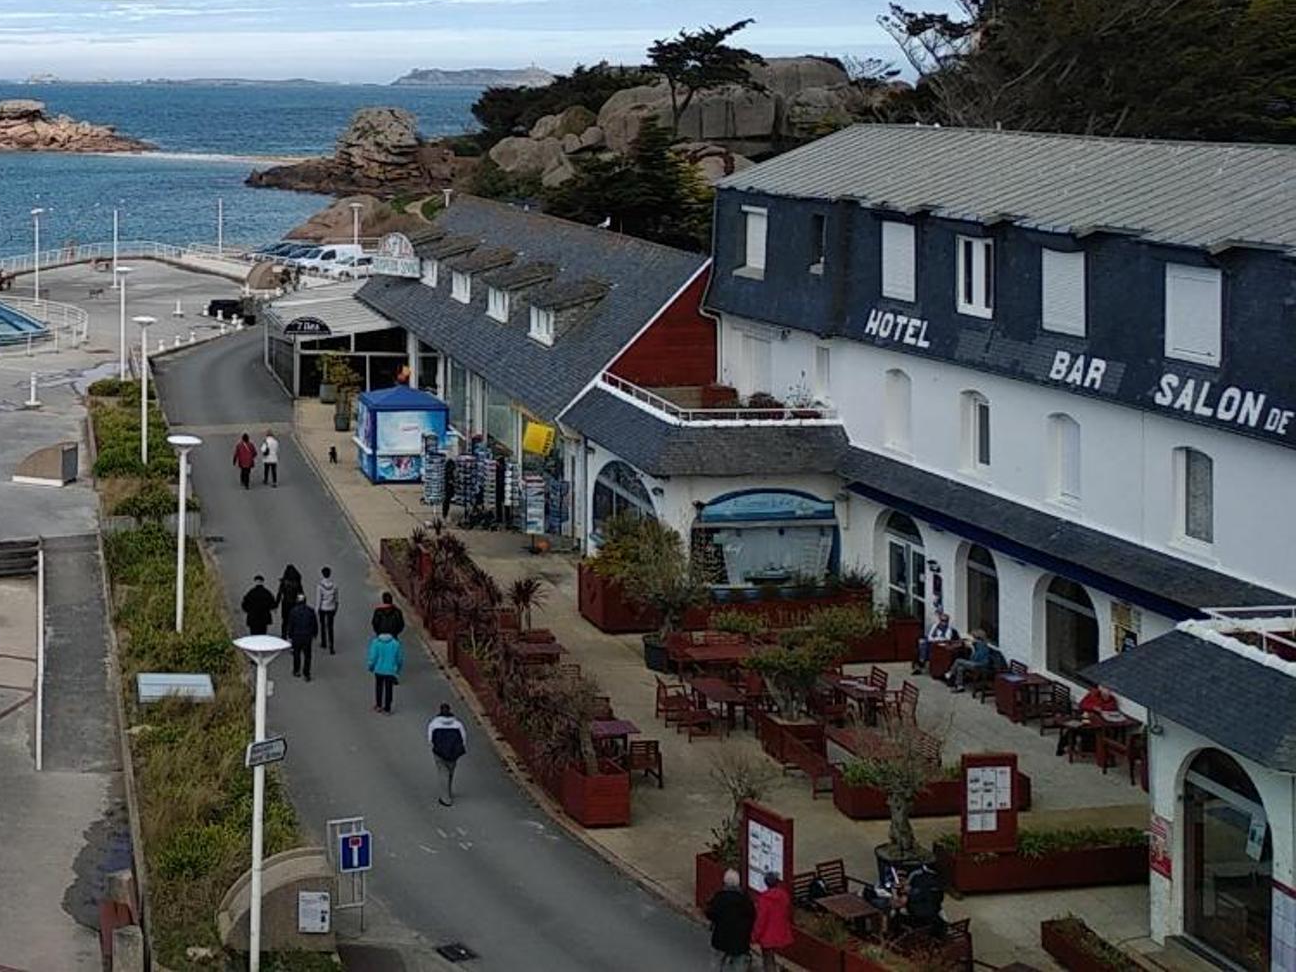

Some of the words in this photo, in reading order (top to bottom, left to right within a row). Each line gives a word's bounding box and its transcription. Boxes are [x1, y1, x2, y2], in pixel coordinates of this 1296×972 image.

[865, 309, 930, 348] HOTEL
[1049, 350, 1107, 390] BAR
[1154, 373, 1266, 427] SALON
[1264, 408, 1295, 435] DE
